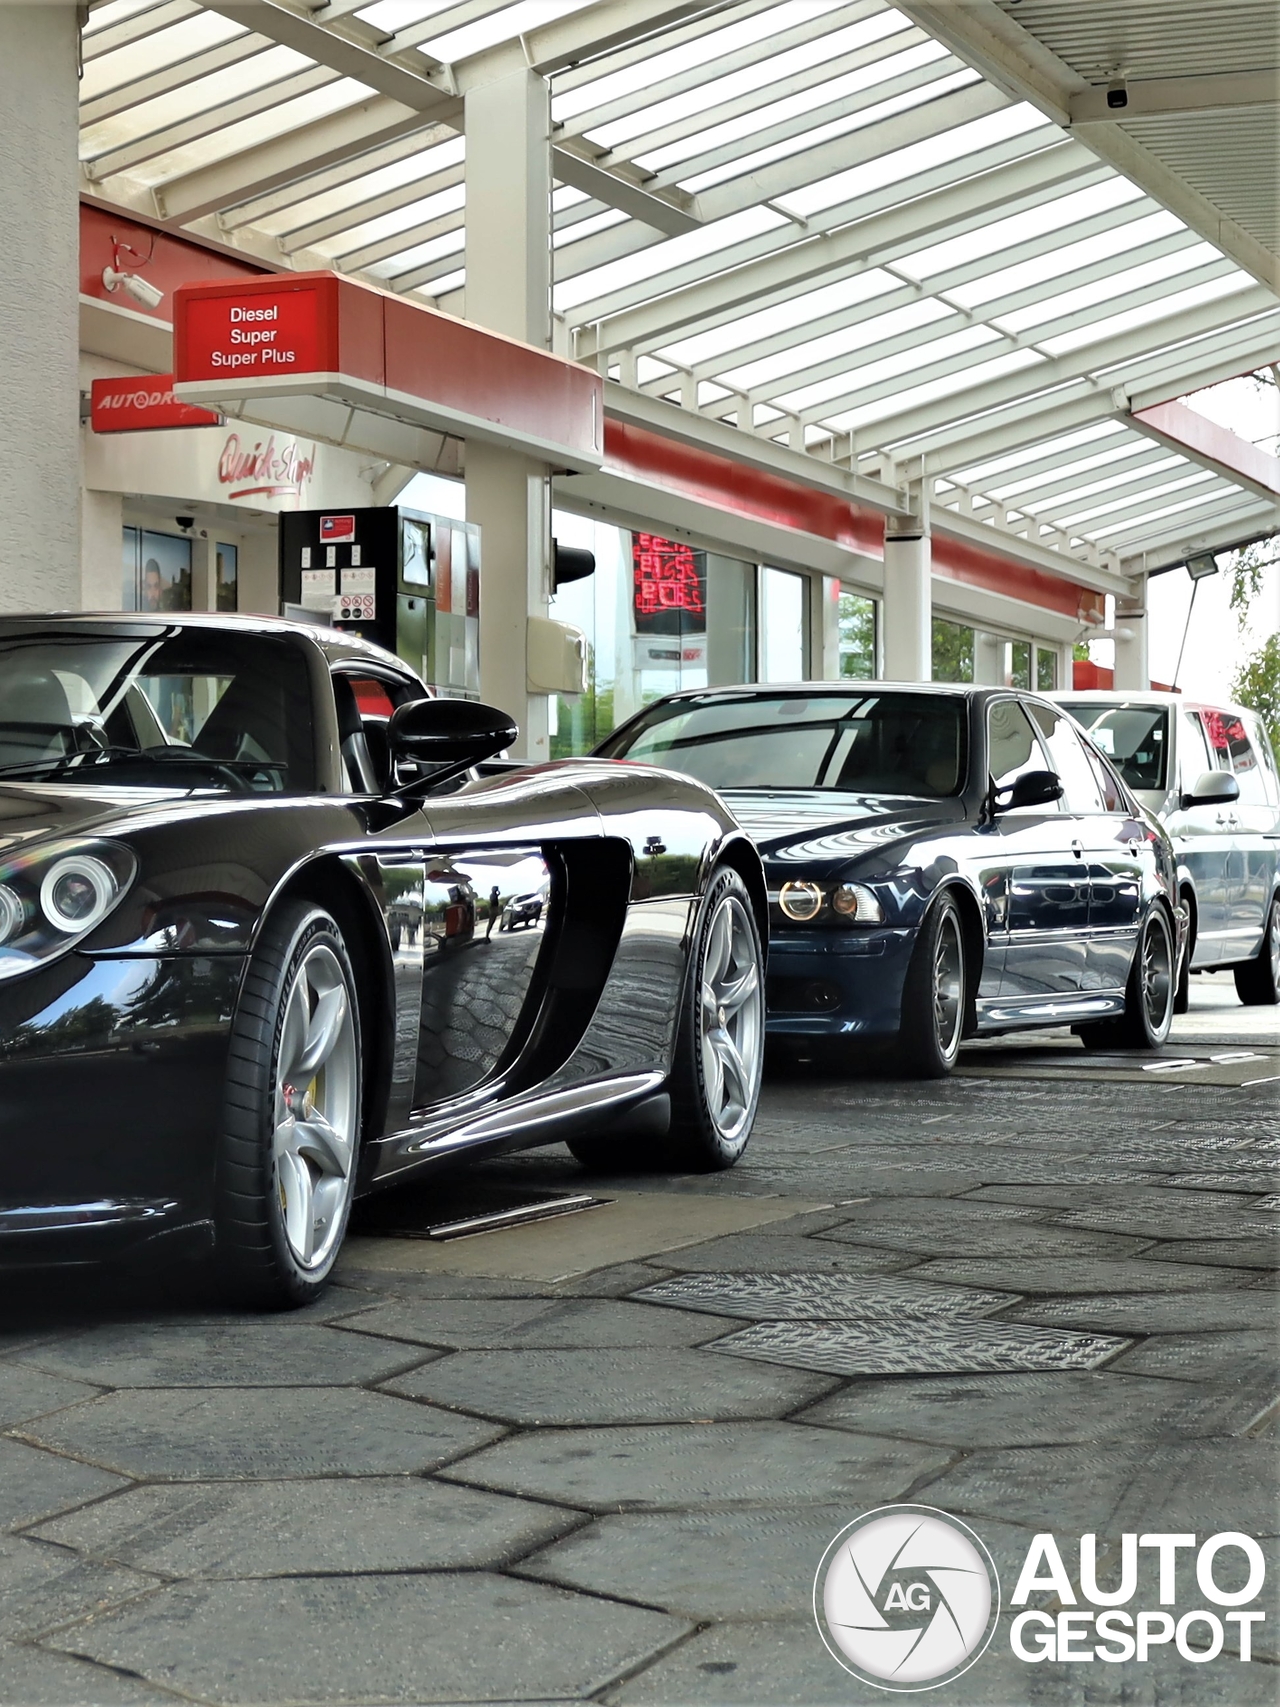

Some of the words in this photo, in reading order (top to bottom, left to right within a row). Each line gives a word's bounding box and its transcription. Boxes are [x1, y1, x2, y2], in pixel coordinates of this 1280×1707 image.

[230, 305, 278, 323] Diesel
[230, 328, 277, 346] Super
[211, 351, 258, 369] Super
[261, 348, 296, 364] Plus
[273, 959, 296, 1060] MICHELIN
